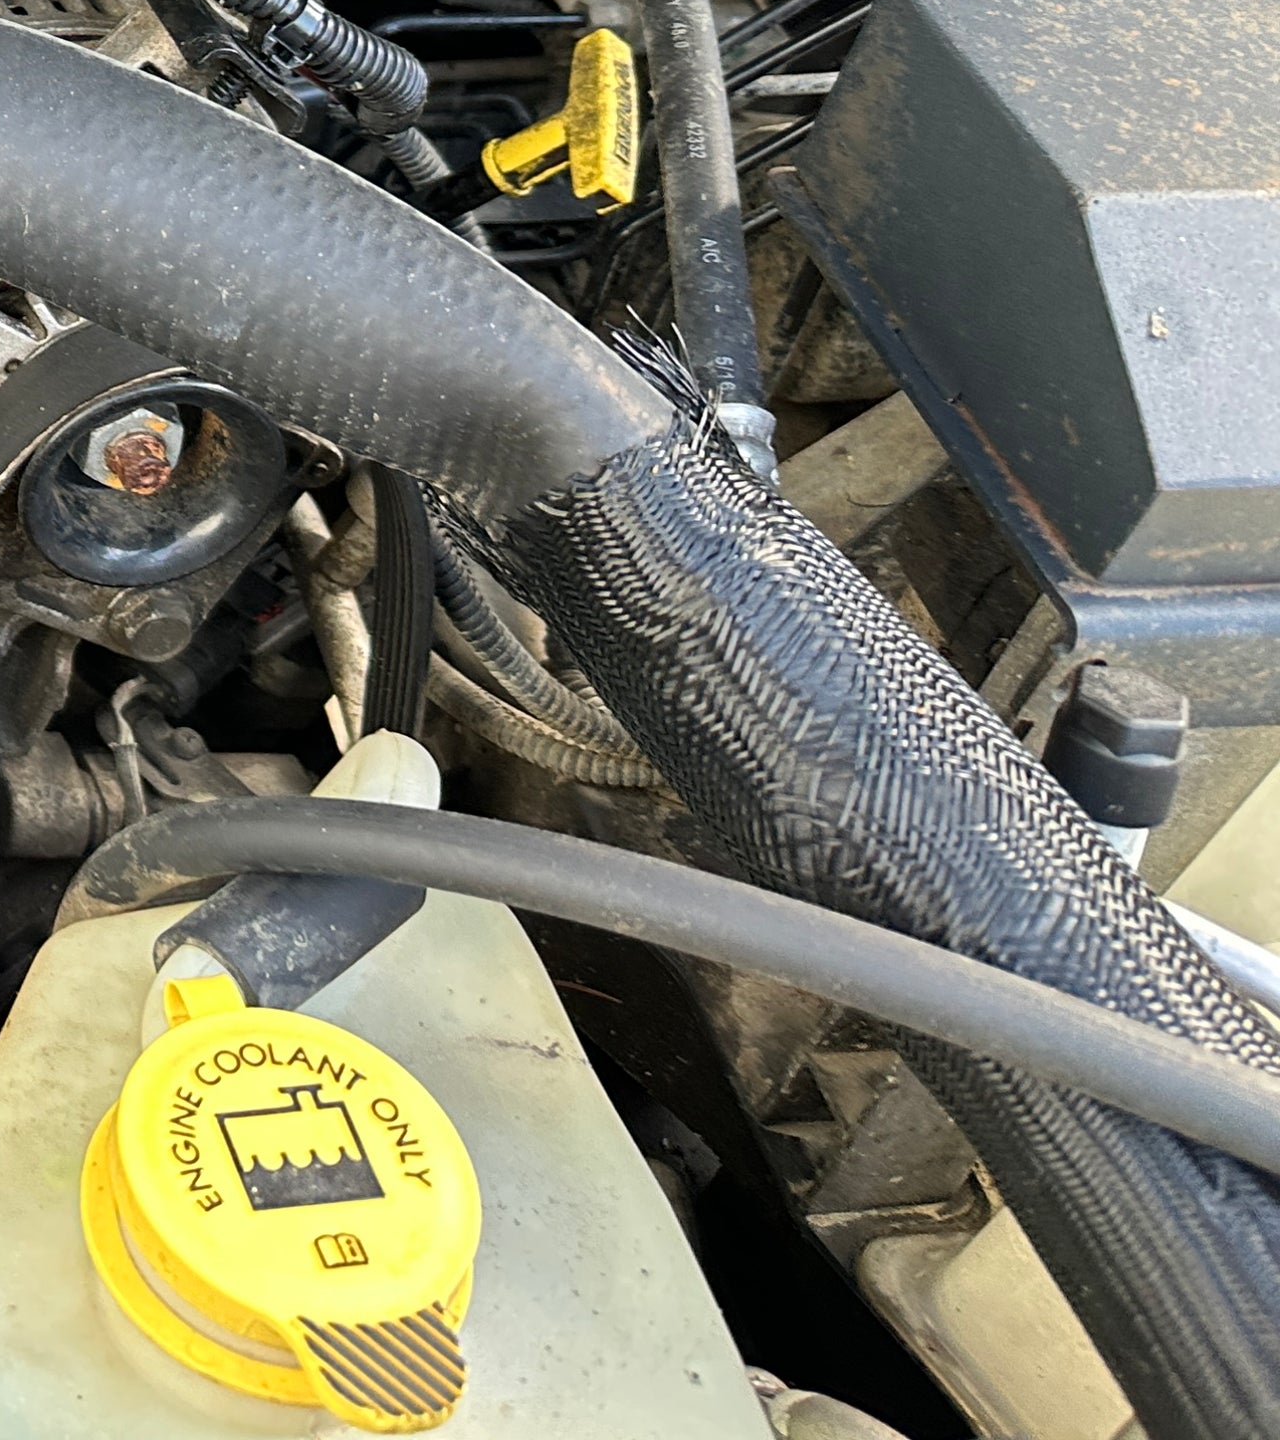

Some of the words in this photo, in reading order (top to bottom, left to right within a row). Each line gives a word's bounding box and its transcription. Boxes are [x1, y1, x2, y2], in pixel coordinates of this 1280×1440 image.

[699, 237, 721, 264] A/C
[714, 355, 738, 392] 5/16
[194, 1042, 368, 1091] COOLANT
[169, 1086, 223, 1212] ENGINE
[371, 1097, 433, 1188] ONLY
